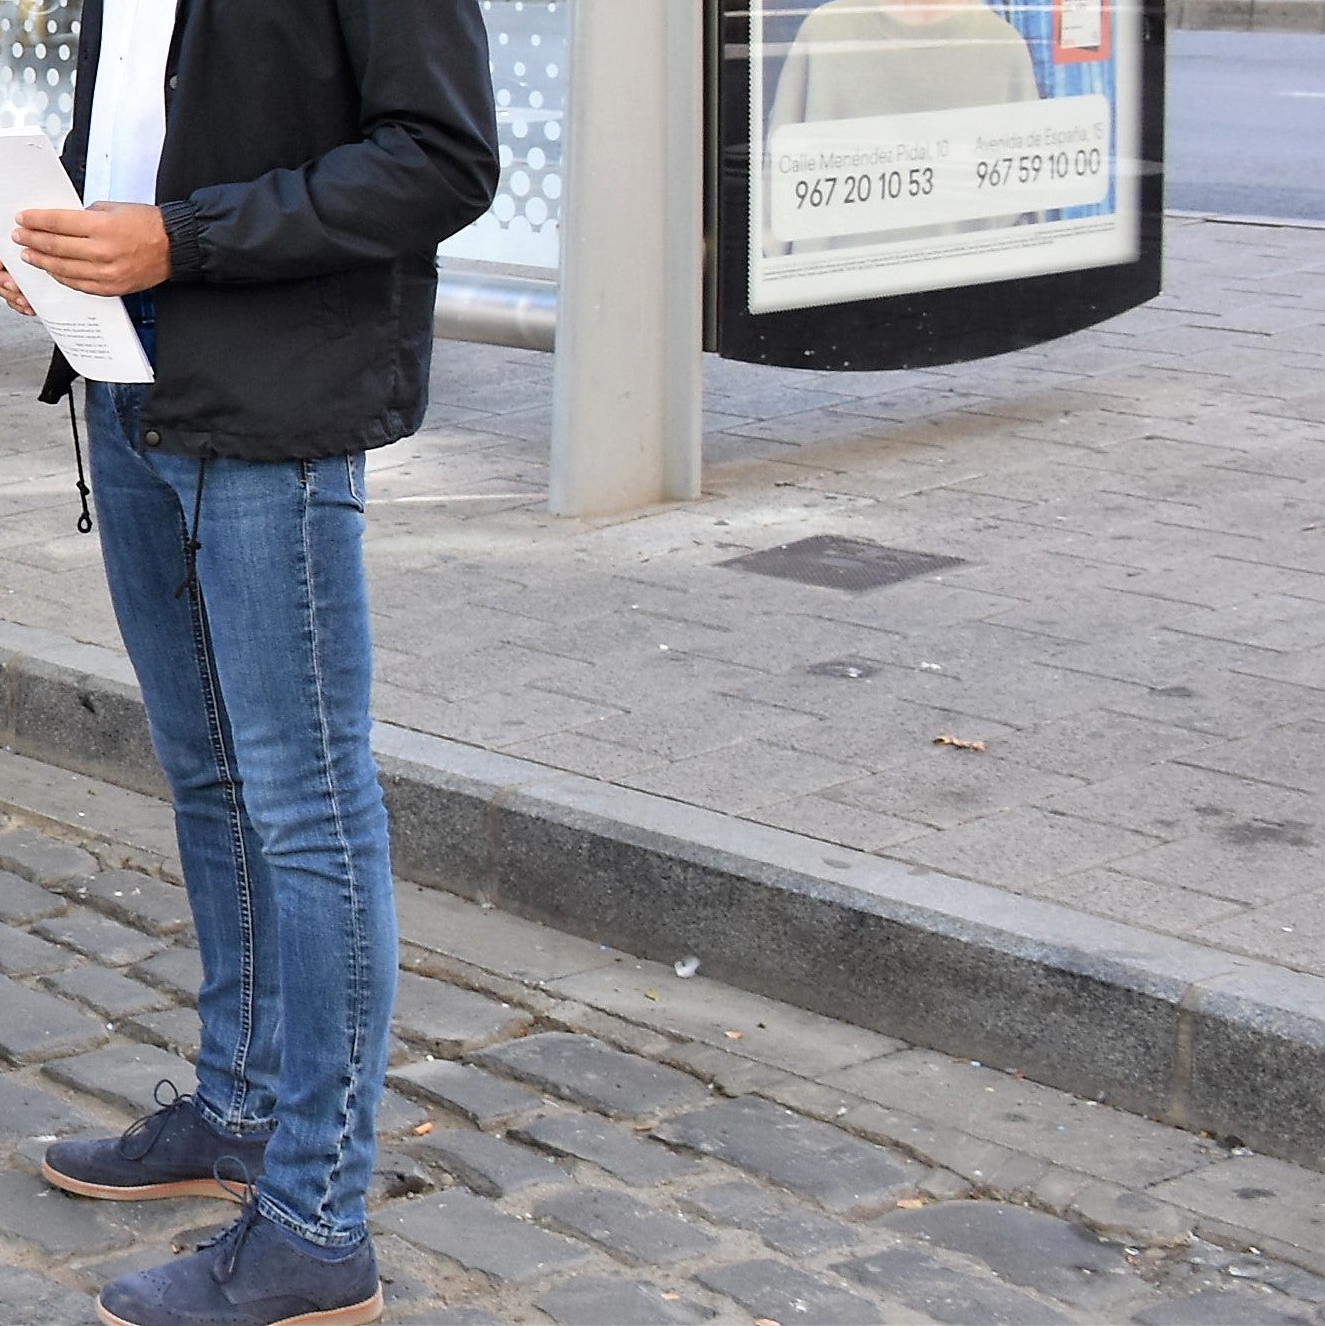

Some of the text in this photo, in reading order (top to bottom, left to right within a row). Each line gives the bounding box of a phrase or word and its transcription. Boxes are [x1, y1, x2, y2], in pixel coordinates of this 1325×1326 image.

[975, 133, 1023, 154] Avenida
[1026, 130, 1043, 148] de
[778, 151, 816, 174] Calle
[819, 146, 894, 170] Menéndez
[976, 148, 1101, 189] 967 59 10 00
[795, 167, 934, 209] 967 20 10 53
